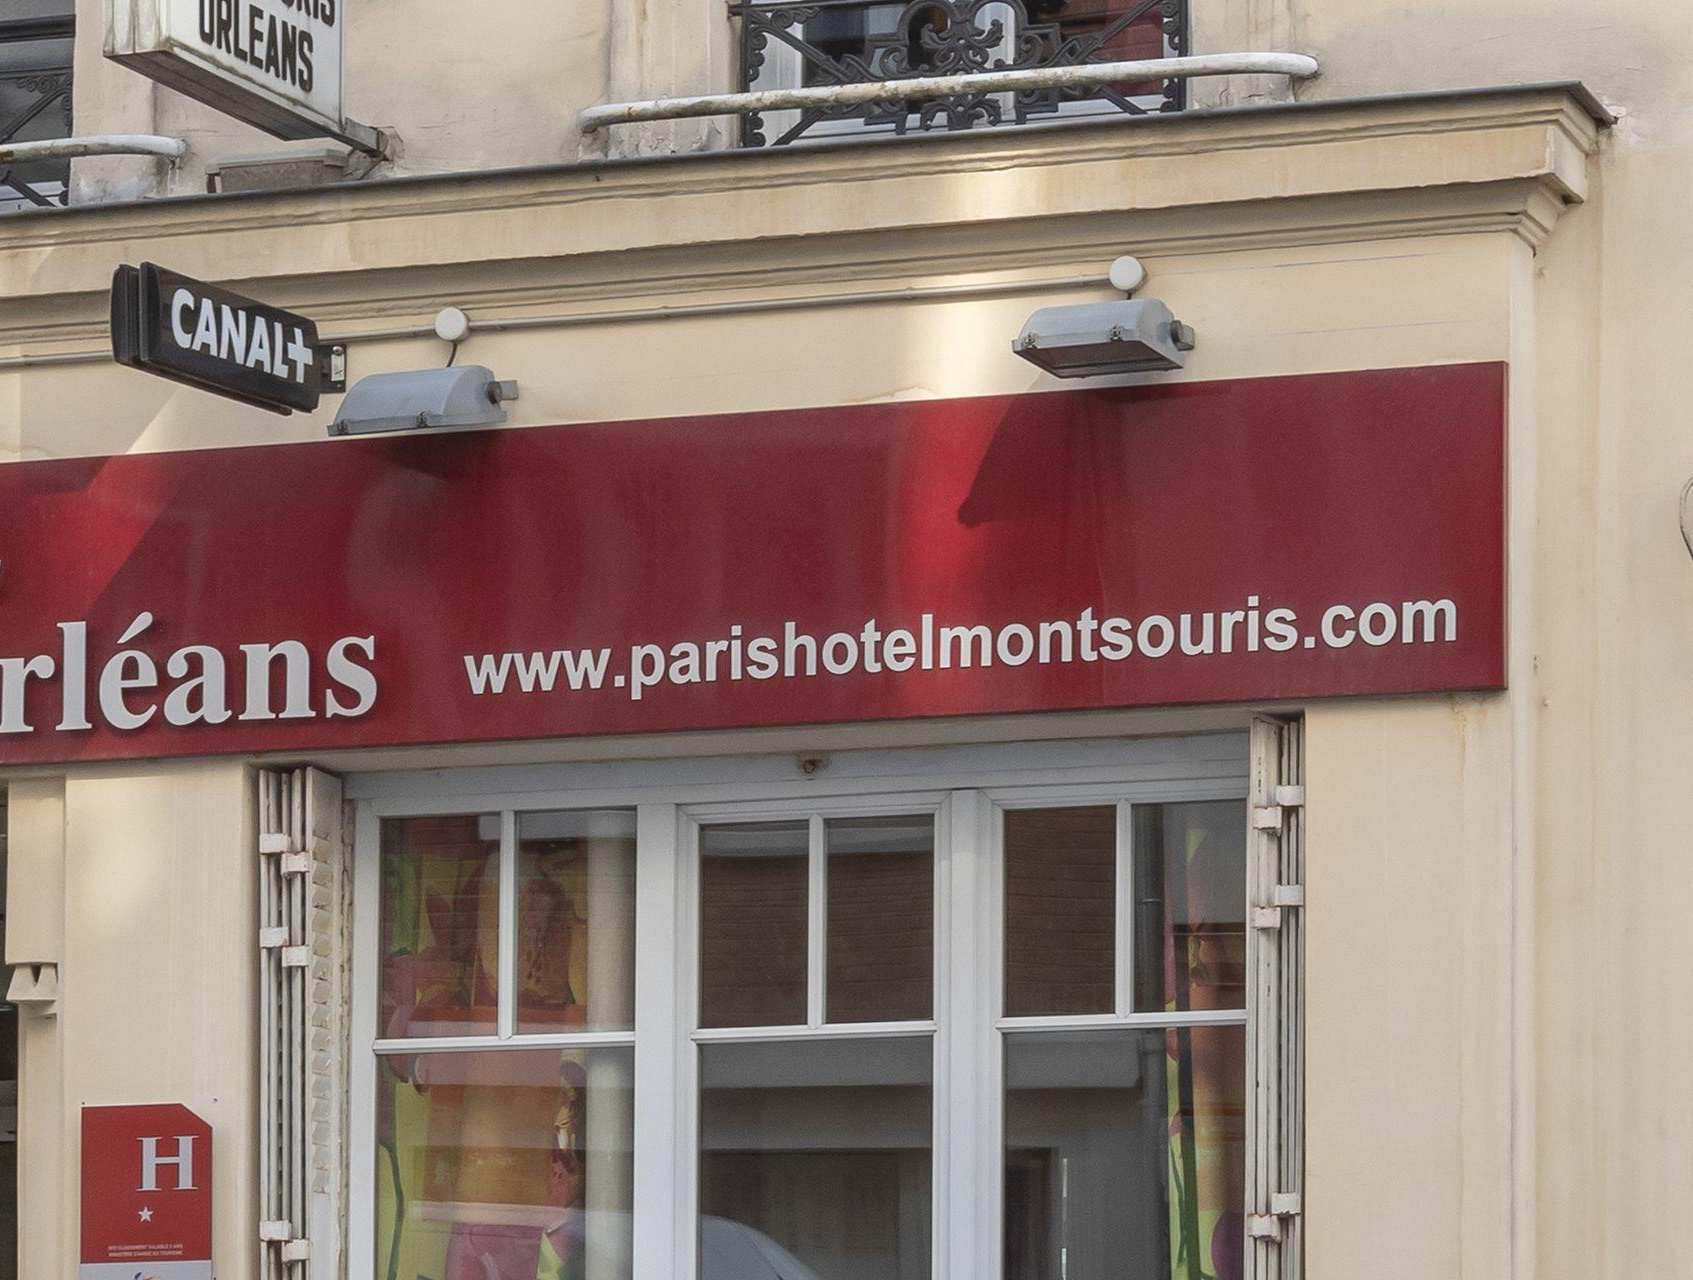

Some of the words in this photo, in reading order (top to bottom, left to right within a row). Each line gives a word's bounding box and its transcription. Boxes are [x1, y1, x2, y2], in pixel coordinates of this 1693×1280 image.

[171, 288, 314, 384] CANAL+
[463, 595, 1459, 699] www.parishotelmontsouris.com
[135, 1135, 200, 1192] H
